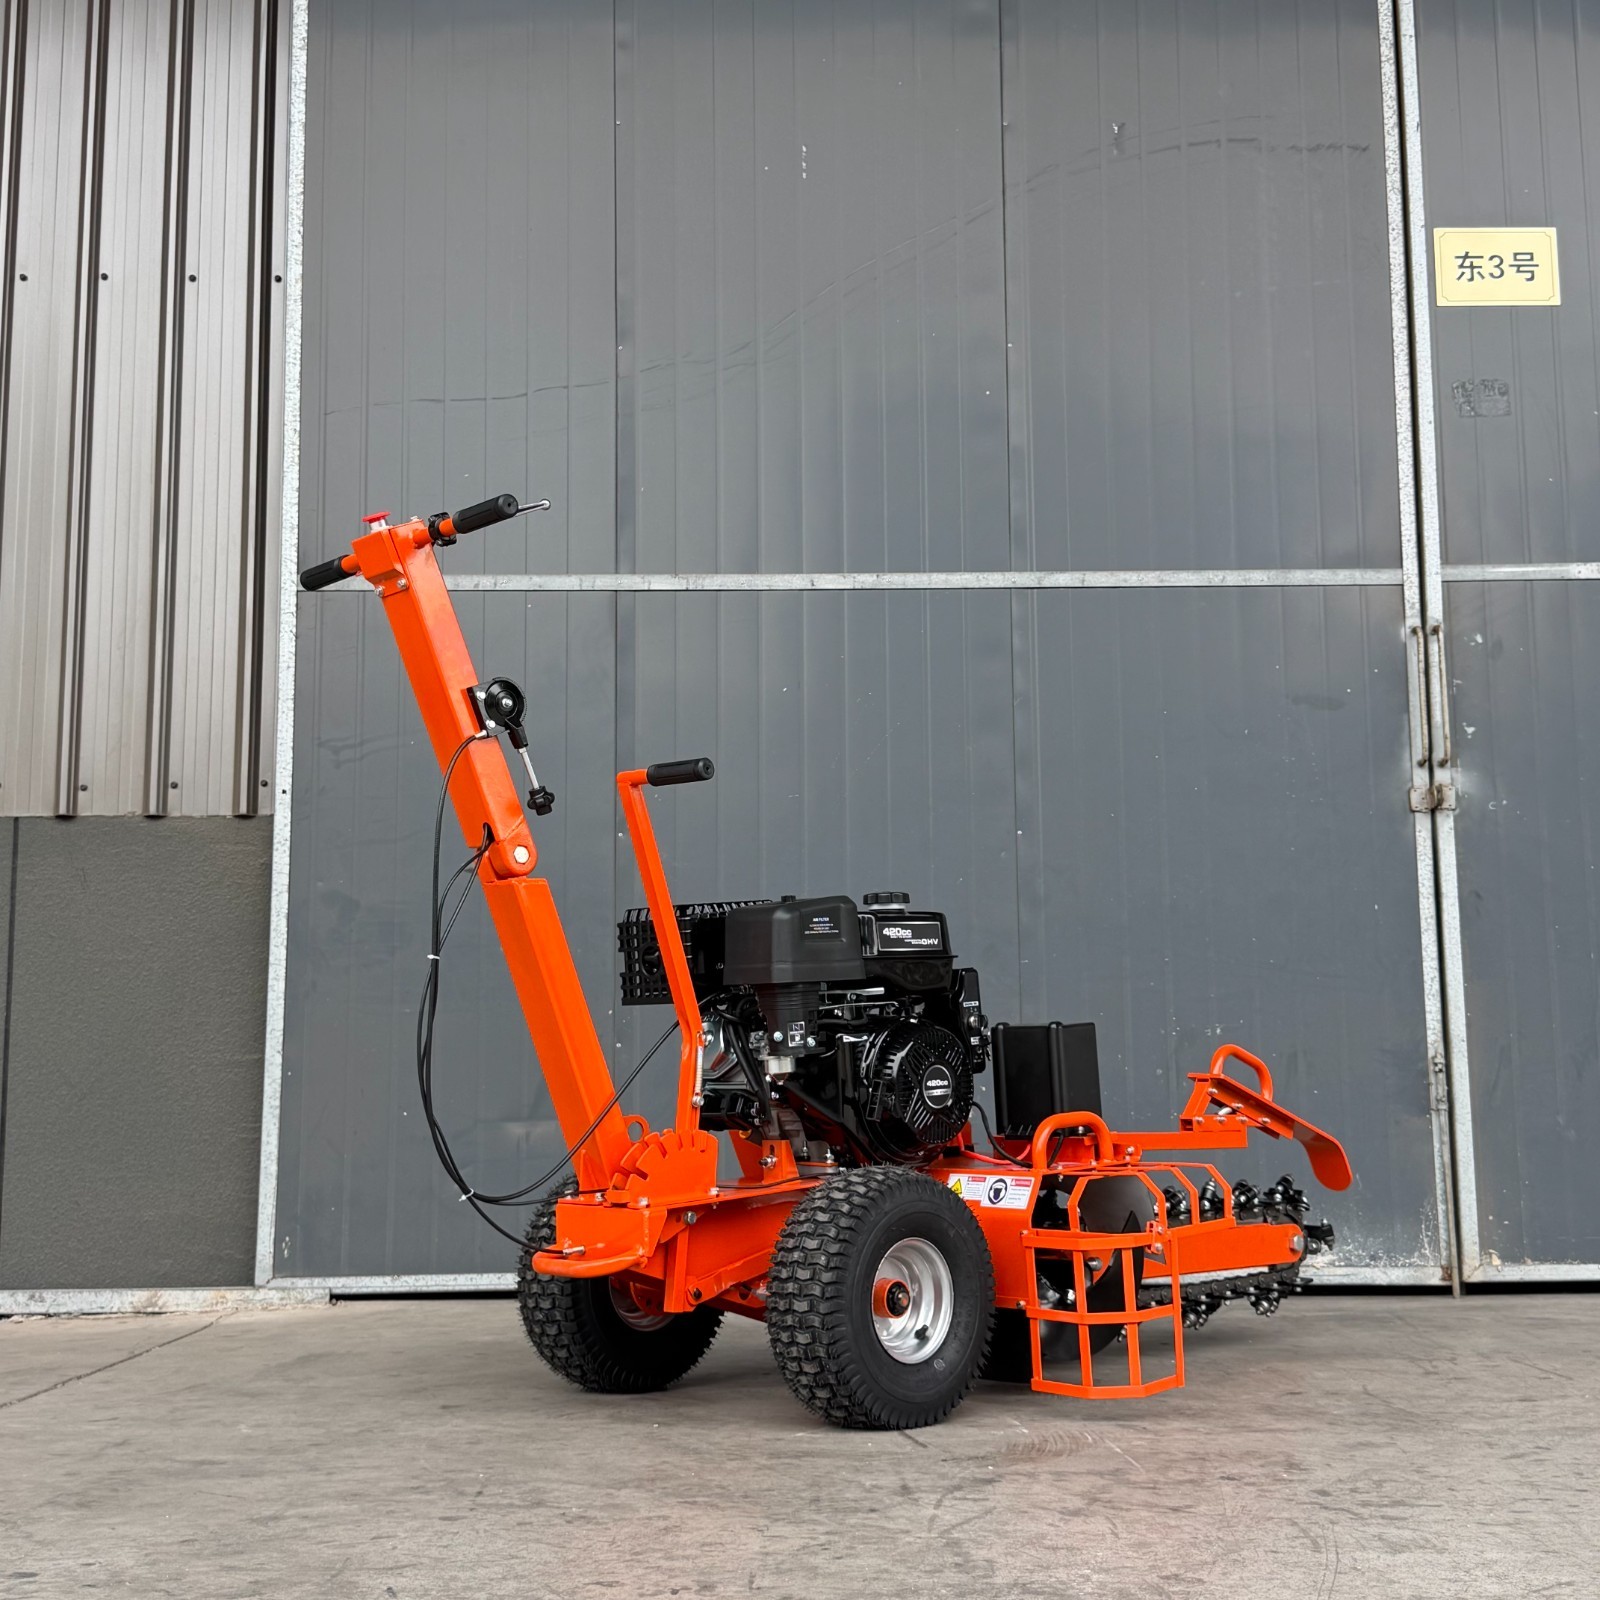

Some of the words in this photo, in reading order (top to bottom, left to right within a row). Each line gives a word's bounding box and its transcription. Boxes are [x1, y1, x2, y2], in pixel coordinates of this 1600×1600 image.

[1454, 251, 1540, 282] 东3号
[883, 927, 912, 936] 420cc
[926, 1079, 949, 1087] 420cc
